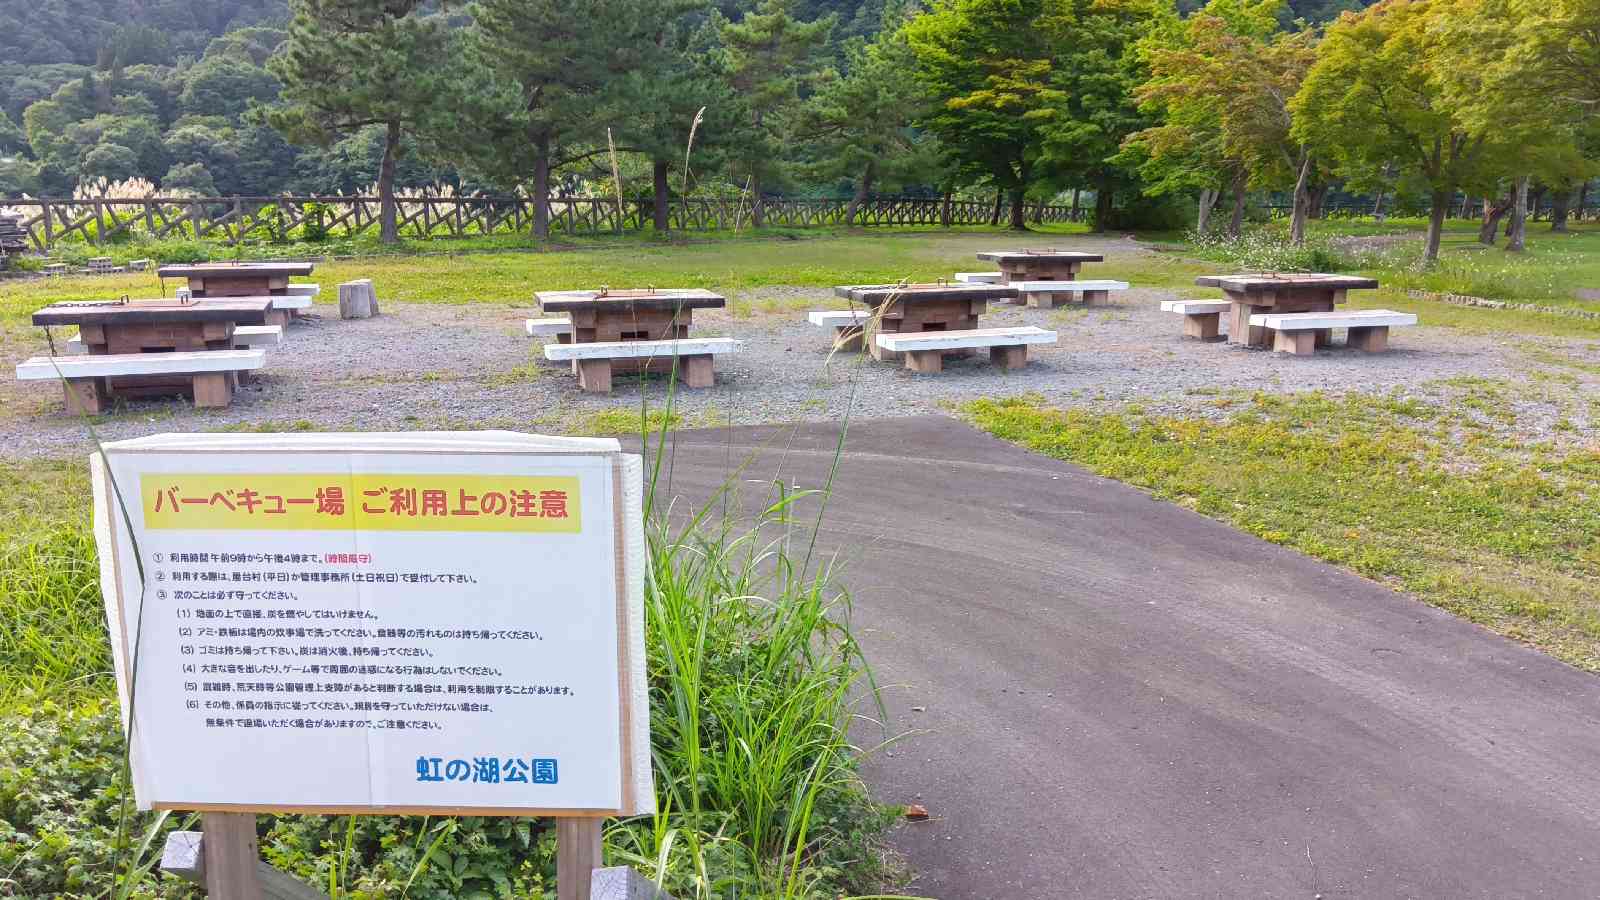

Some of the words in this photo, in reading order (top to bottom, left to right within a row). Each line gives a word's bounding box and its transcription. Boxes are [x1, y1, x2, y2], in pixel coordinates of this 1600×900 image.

[155, 486, 344, 516] バーベキュー場
[362, 486, 568, 517] ご利用上の注意
[177, 608, 190, 618] (1)
[179, 627, 192, 637] (2)
[181, 645, 194, 656] (3)
[182, 662, 196, 674] (4)
[185, 680, 197, 691] (5)
[186, 699, 199, 709] (6)
[416, 756, 558, 784] 虹の湖公園
